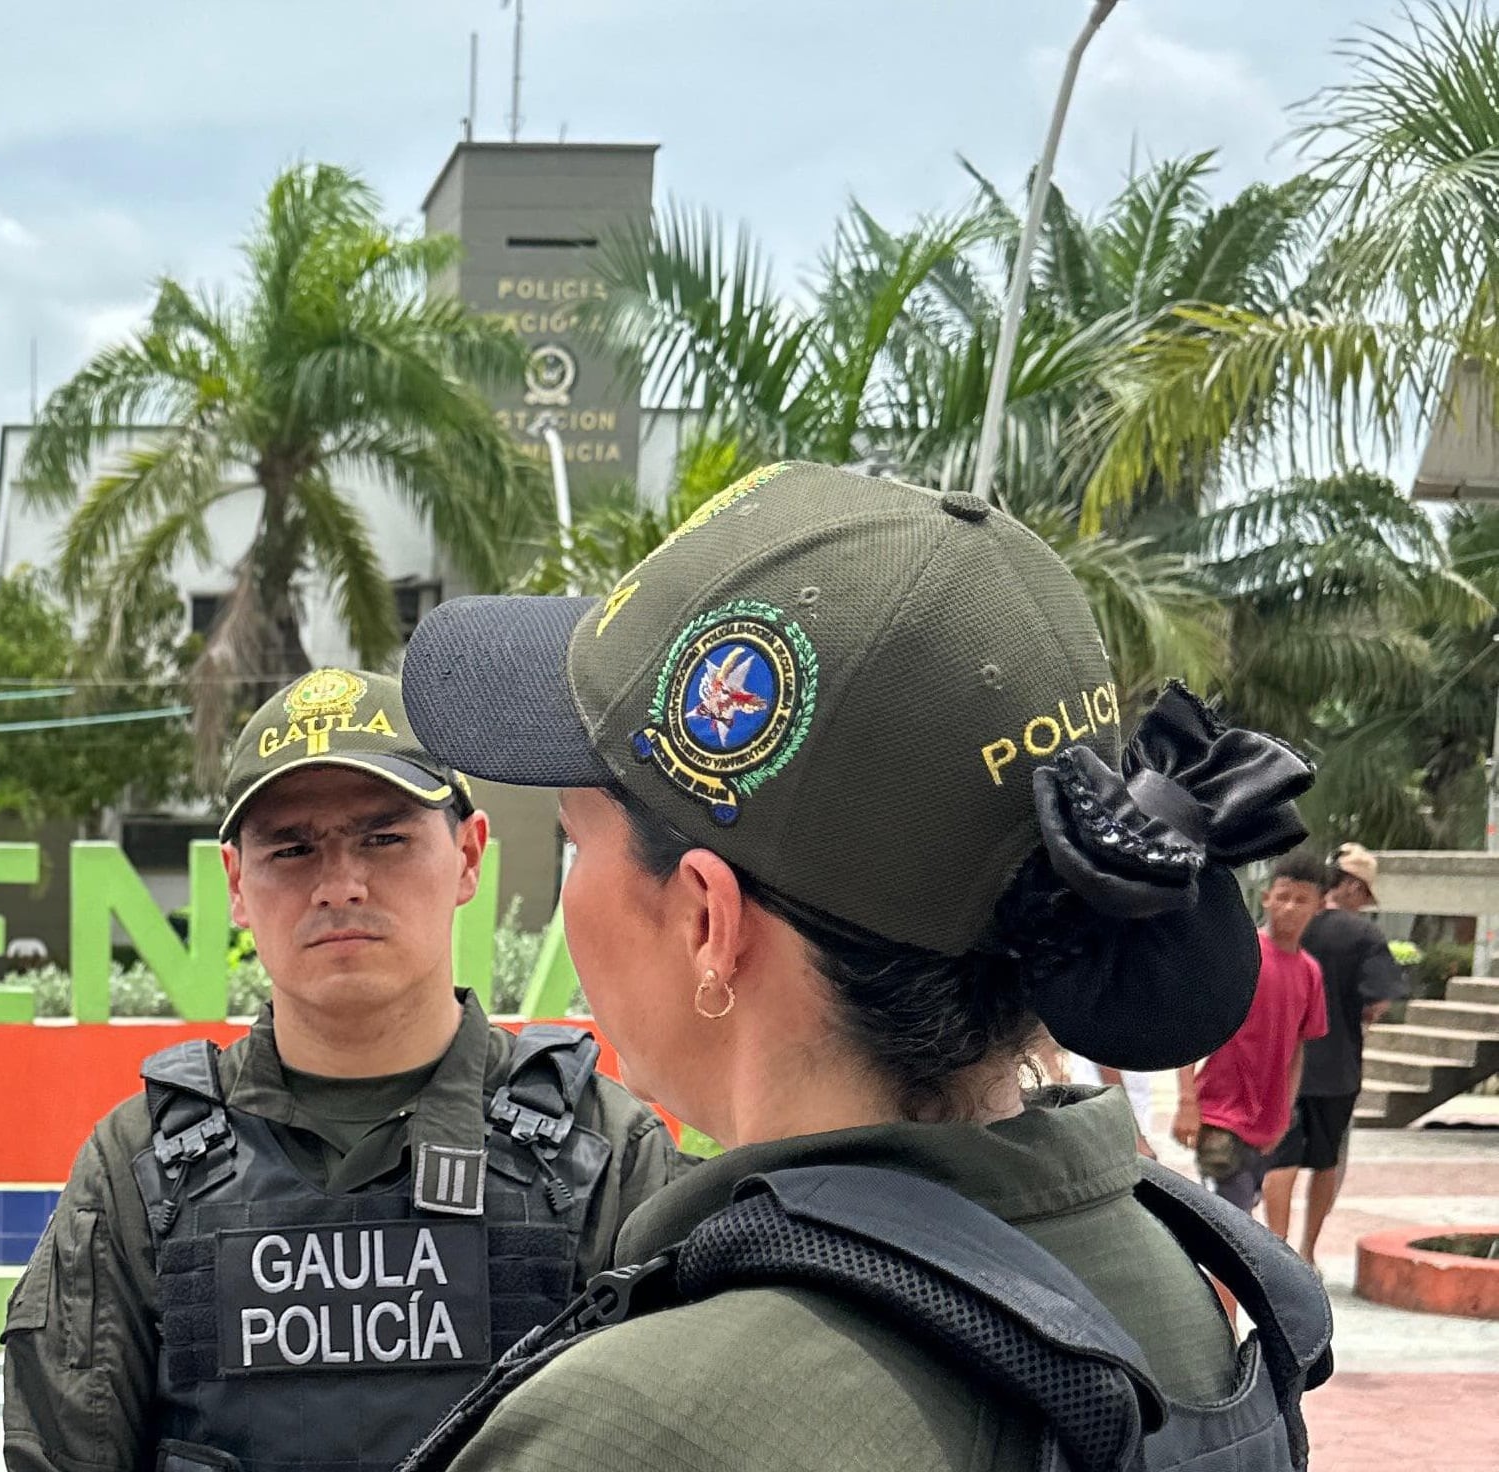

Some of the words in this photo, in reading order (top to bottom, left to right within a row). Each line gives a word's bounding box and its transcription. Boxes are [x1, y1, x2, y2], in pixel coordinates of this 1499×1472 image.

[258, 708, 398, 758] GAULA
[981, 681, 1120, 786] POLICI
[251, 1228, 448, 1293] GAULA
[241, 1290, 463, 1367] POLICÍA
